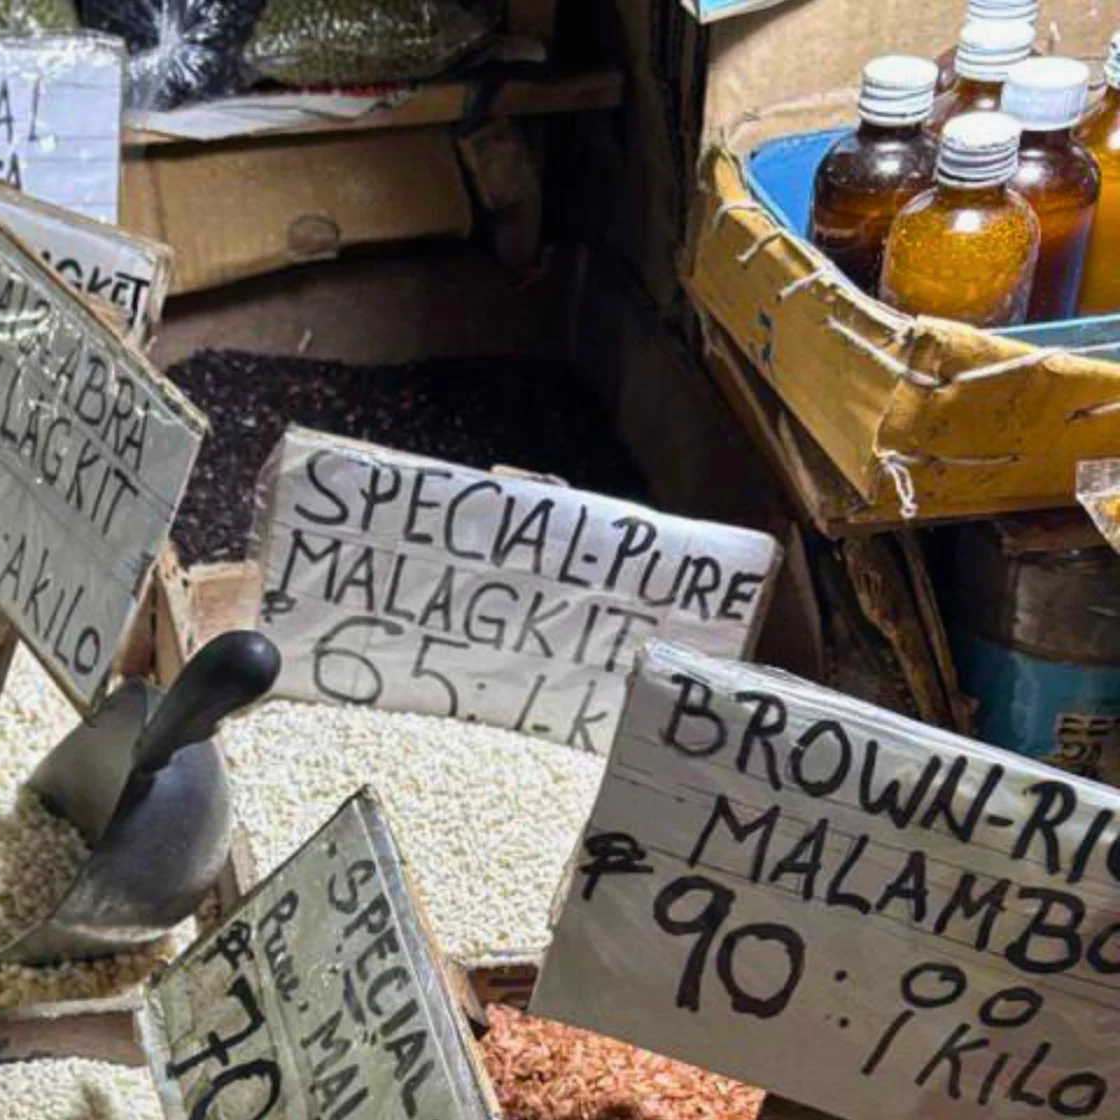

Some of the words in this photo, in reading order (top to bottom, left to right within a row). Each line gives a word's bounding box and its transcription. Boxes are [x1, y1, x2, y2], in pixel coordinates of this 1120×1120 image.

[279, 529, 658, 673] MALAGKIT
[294, 449, 767, 622] SPECIAL-PURE
[660, 673, 1120, 886] BROWN-RI
